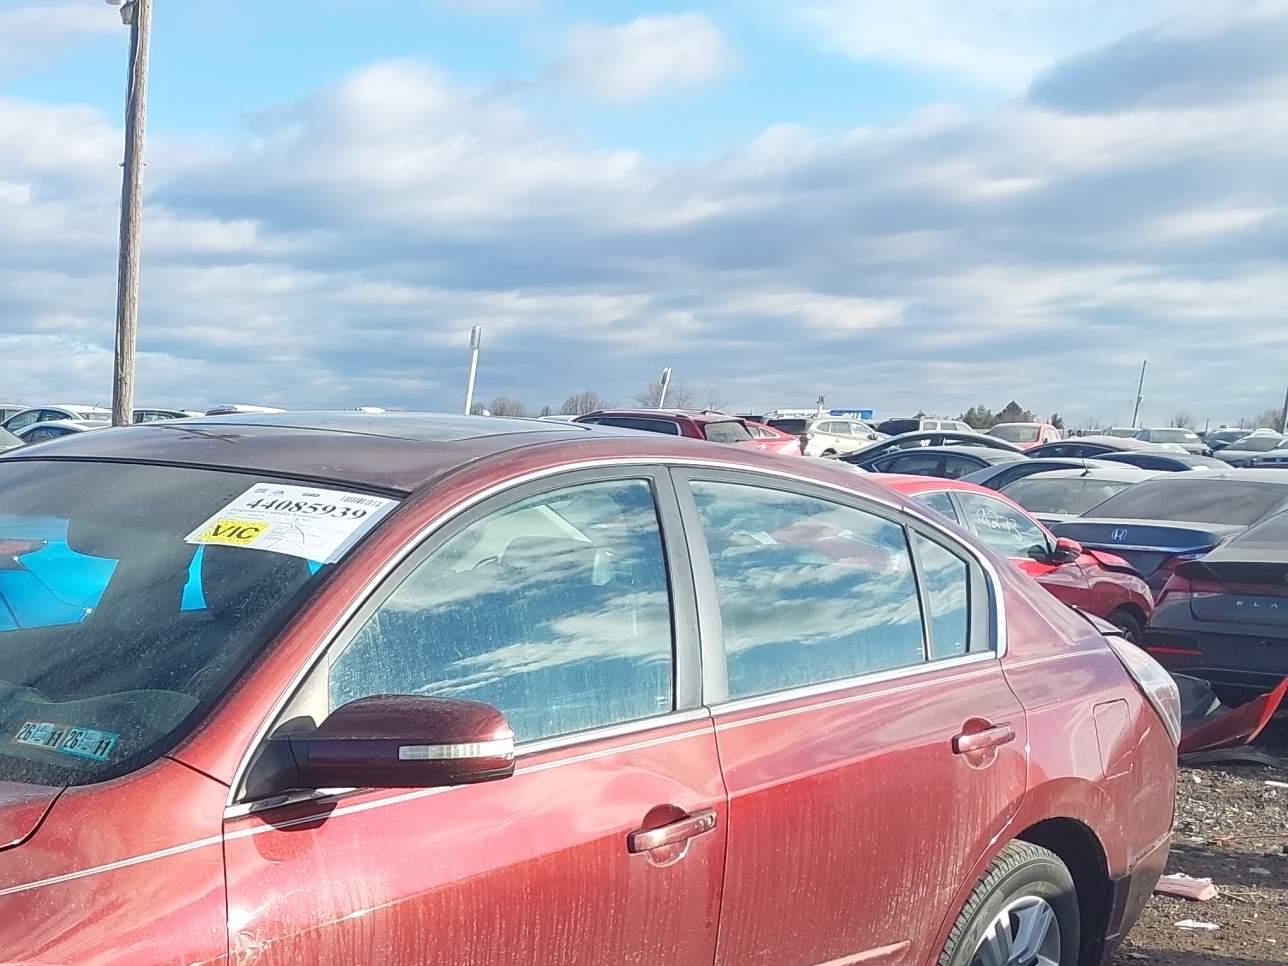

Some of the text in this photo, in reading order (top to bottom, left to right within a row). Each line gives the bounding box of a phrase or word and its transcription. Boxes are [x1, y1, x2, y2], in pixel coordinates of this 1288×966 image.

[246, 498, 368, 520] 44085939
[212, 524, 260, 540] VIC
[17, 723, 64, 747] 26 11
[63, 731, 112, 756] 26 11
